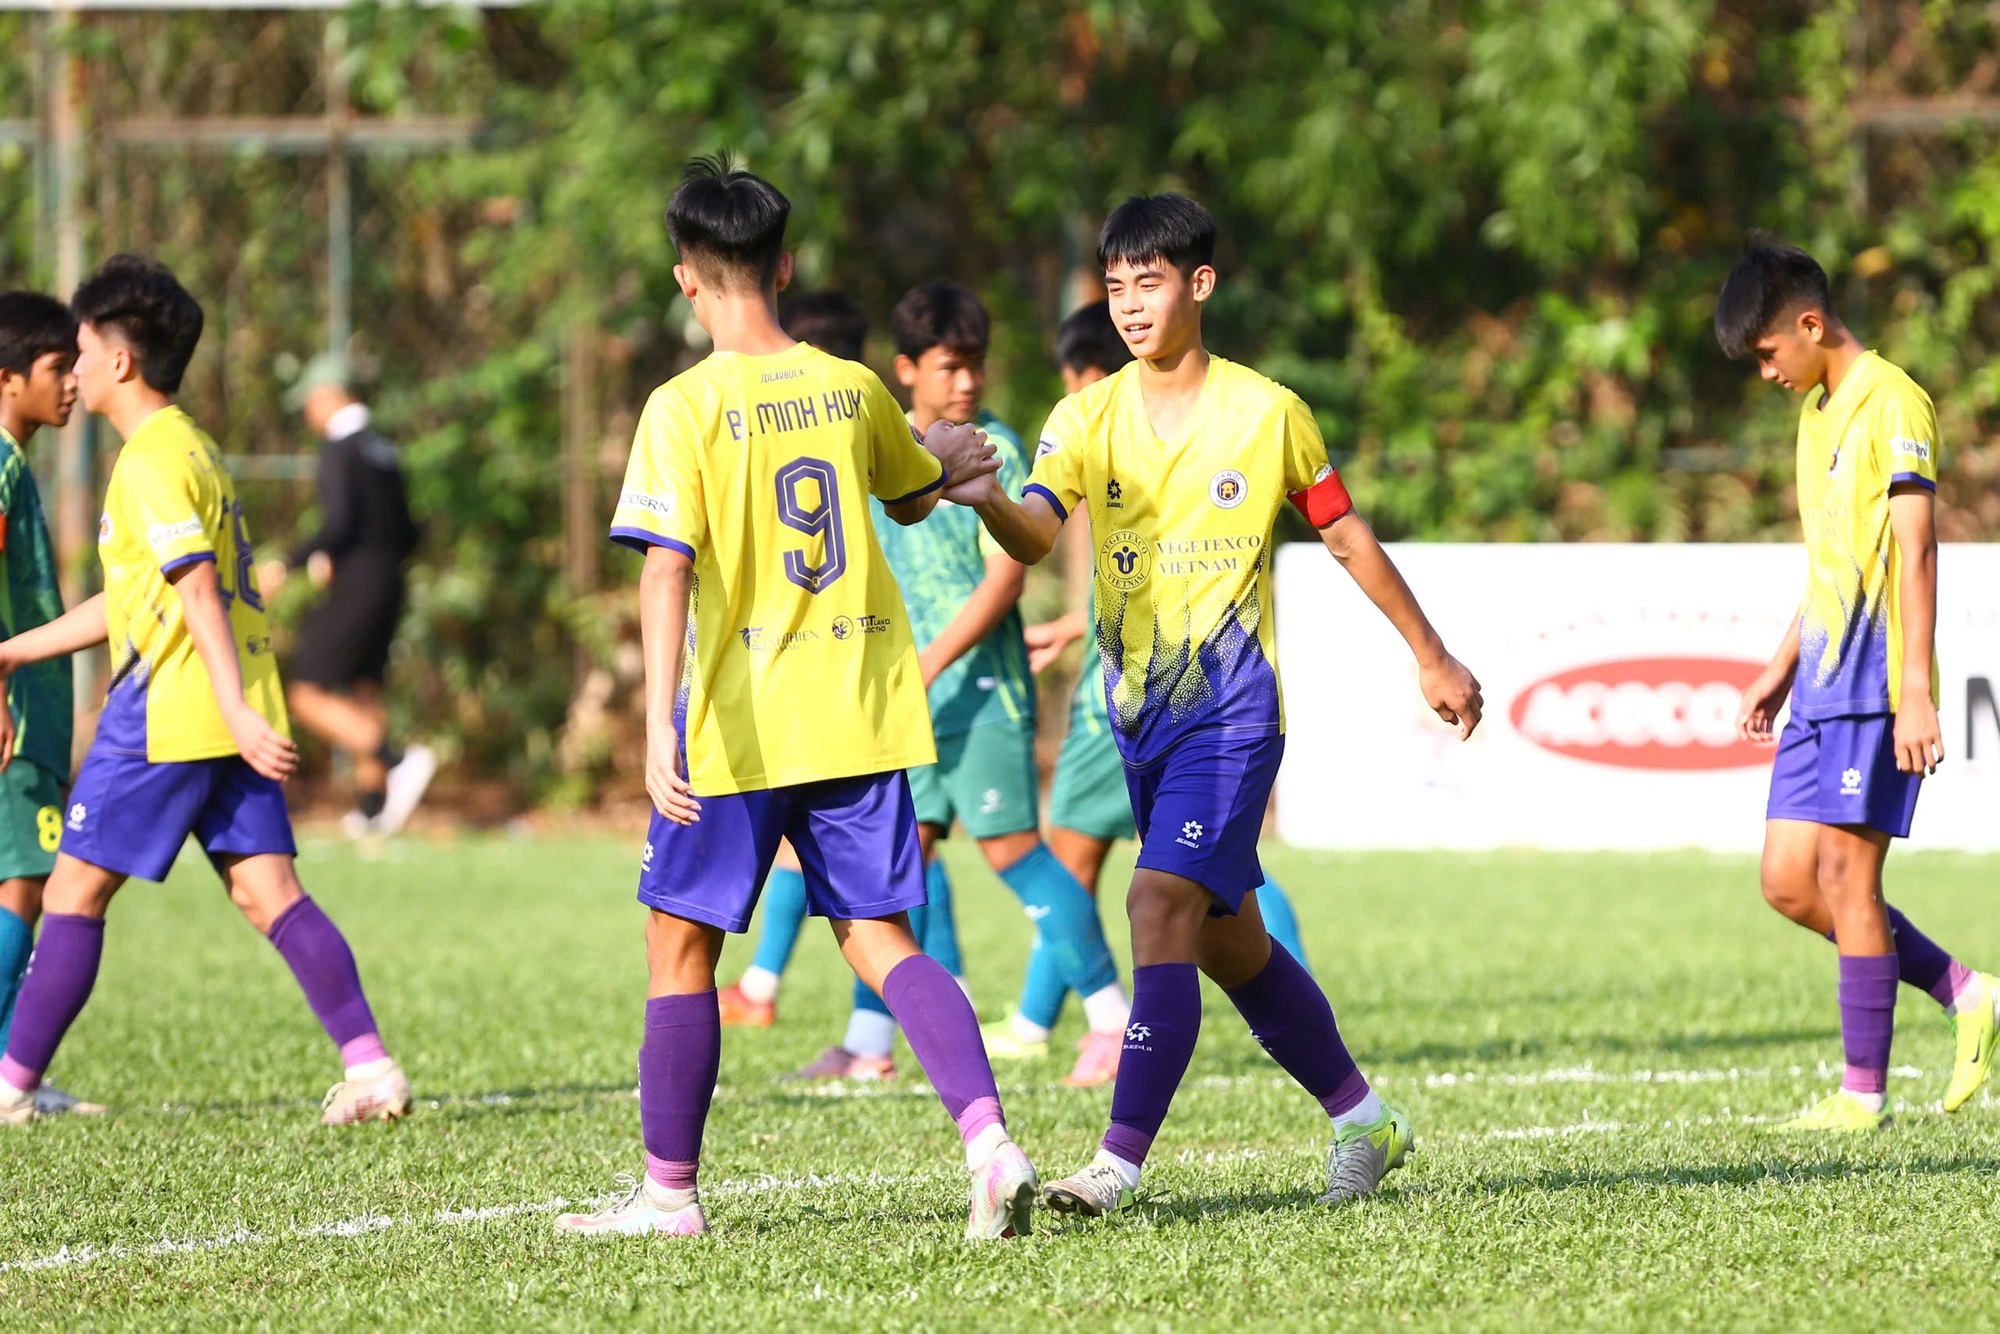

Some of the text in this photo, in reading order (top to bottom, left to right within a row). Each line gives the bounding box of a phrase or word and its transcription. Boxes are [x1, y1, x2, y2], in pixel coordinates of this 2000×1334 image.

[756, 396, 818, 434] MINH
[823, 389, 861, 423] HUY
[775, 456, 846, 595] 9
[1102, 532, 1148, 555] VEGETEXCO
[1157, 535, 1261, 555] VEGETEXCO
[1160, 558, 1238, 575] VIETNAM
[1107, 573, 1146, 588] VIETNAM
[36, 805, 63, 853] 8
